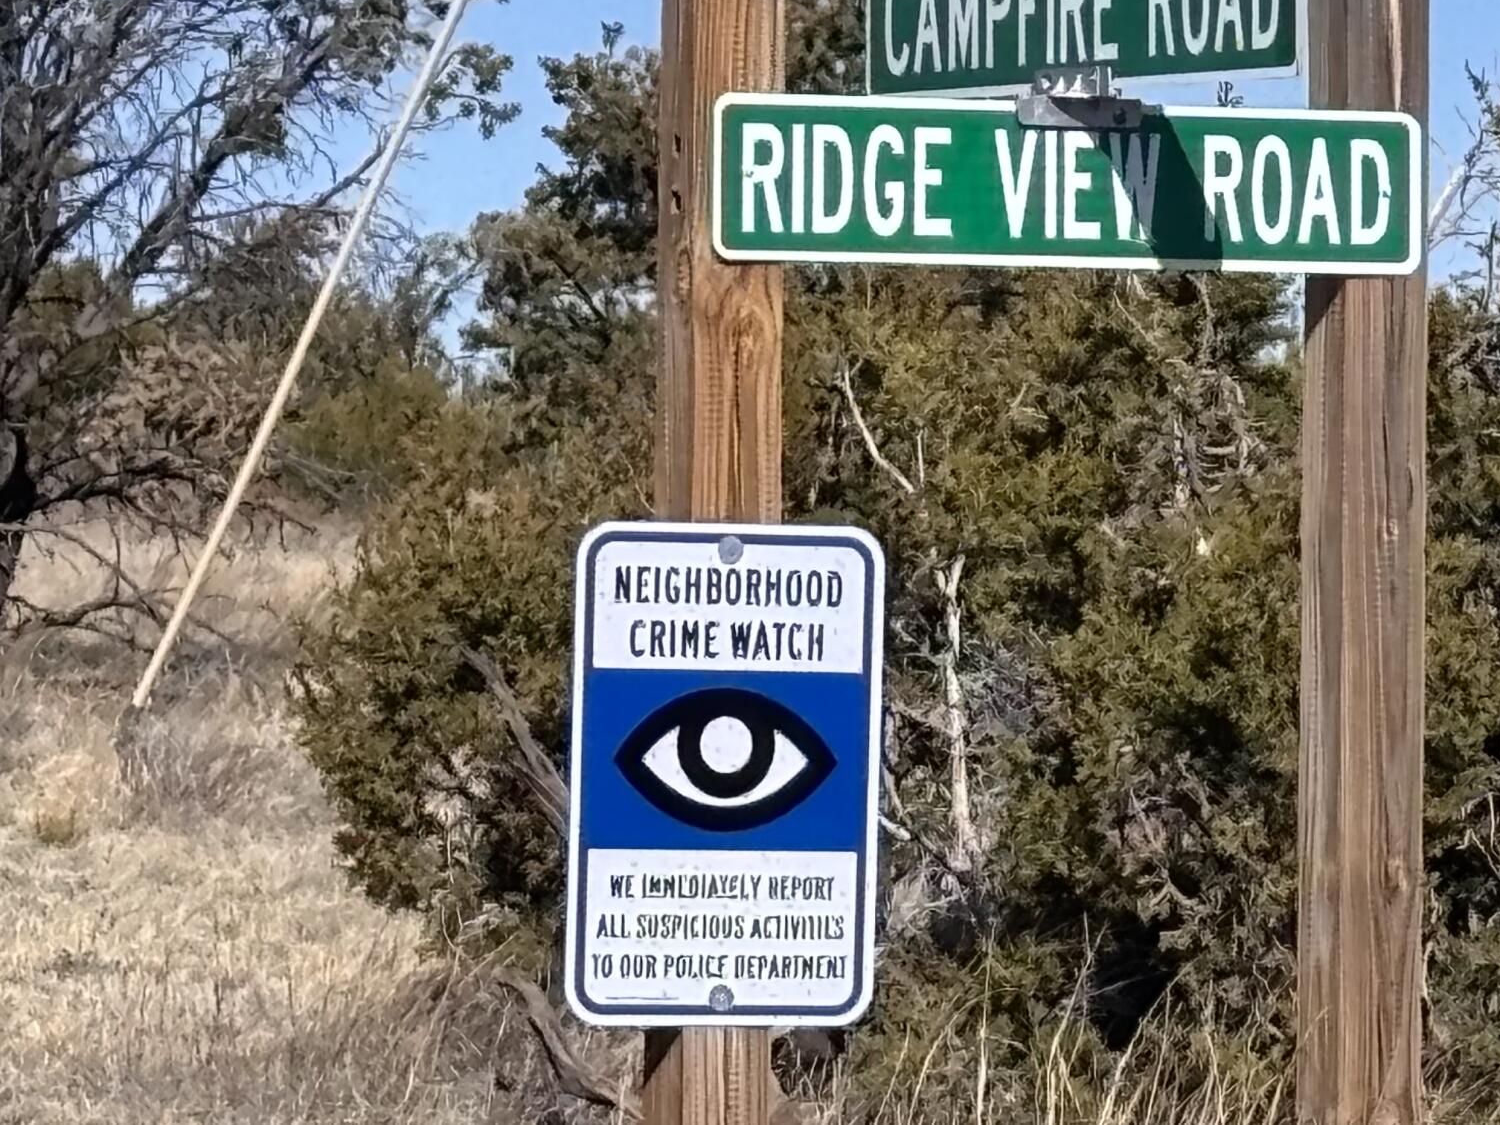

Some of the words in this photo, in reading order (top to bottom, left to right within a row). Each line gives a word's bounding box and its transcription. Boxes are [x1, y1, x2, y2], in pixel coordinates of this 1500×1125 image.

[741, 122, 952, 236] RIDGE
[995, 128, 1161, 240] VIEW
[1203, 134, 1390, 245] ROAD
[614, 565, 843, 608] NEIGHBORHOOD
[629, 620, 720, 659] CRIME
[730, 620, 825, 661] WATCH
[610, 874, 634, 898] WE
[768, 876, 836, 901] REPORT
[596, 914, 631, 939] ALL
[636, 914, 745, 940] SUSPICIOUS
[619, 954, 657, 979] OUR
[663, 955, 727, 979] POLICE
